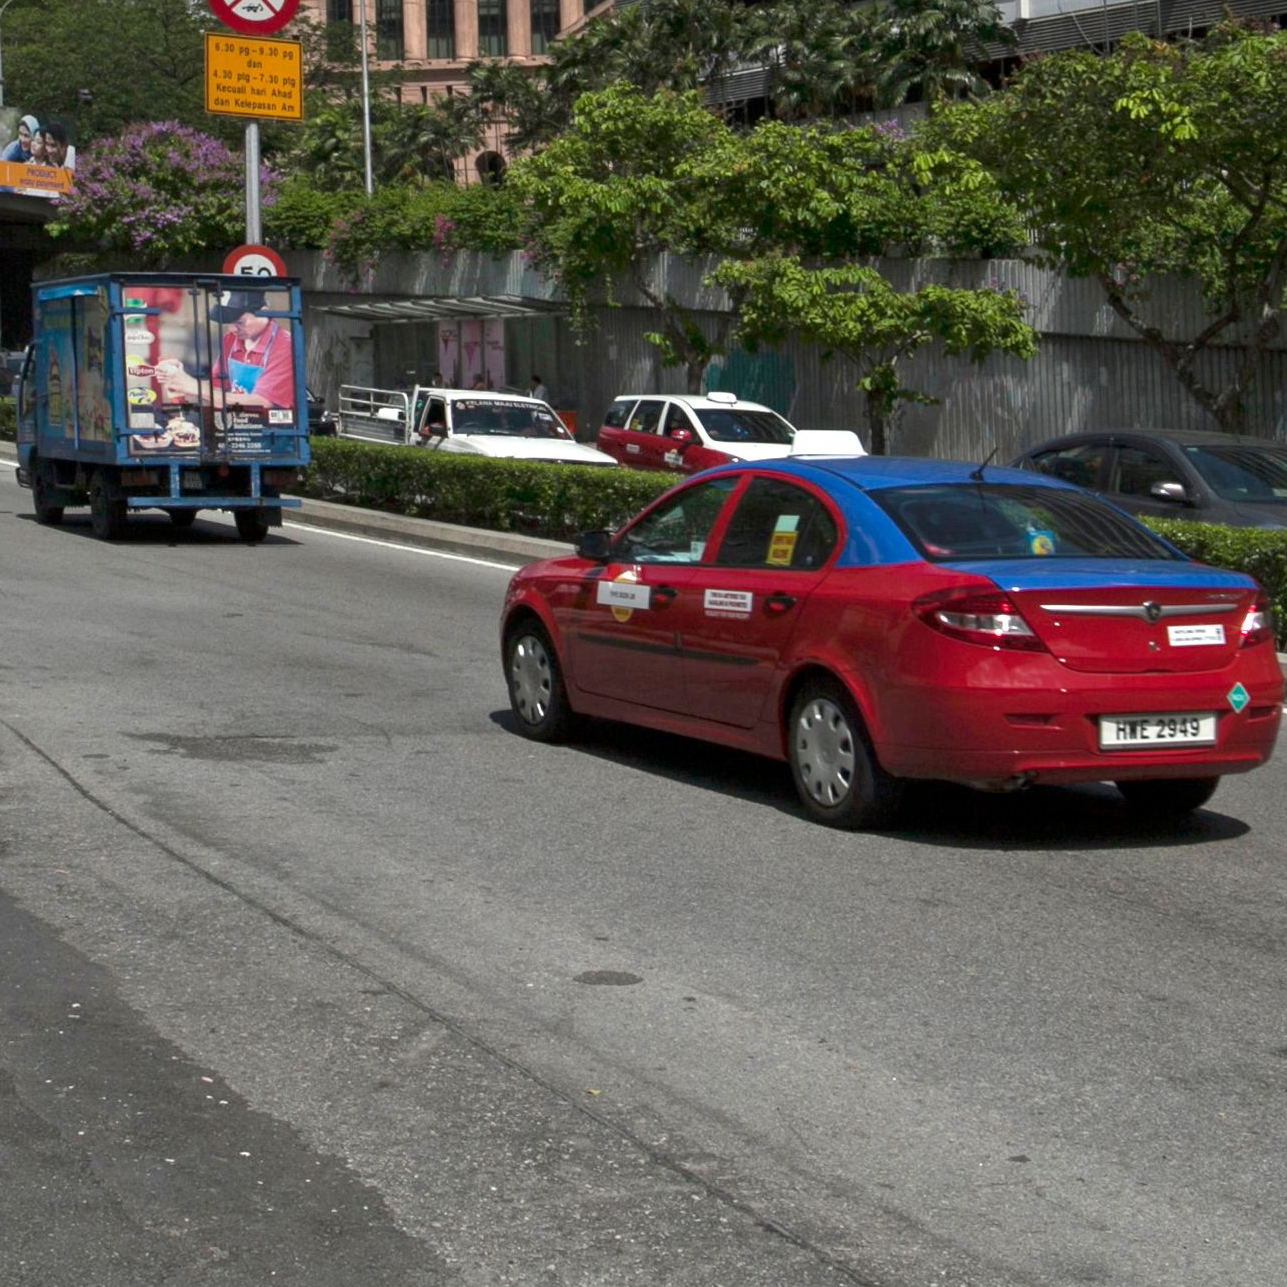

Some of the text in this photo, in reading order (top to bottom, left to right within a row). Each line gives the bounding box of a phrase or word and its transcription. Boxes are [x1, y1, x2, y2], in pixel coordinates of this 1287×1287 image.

[247, 58, 263, 69] dan
[216, 83, 292, 99] Kecuali hari Ahad
[214, 96, 295, 113] dan Kelepasan Am
[129, 364, 155, 377] Lipton
[1115, 718, 1200, 741] HWE 2949
